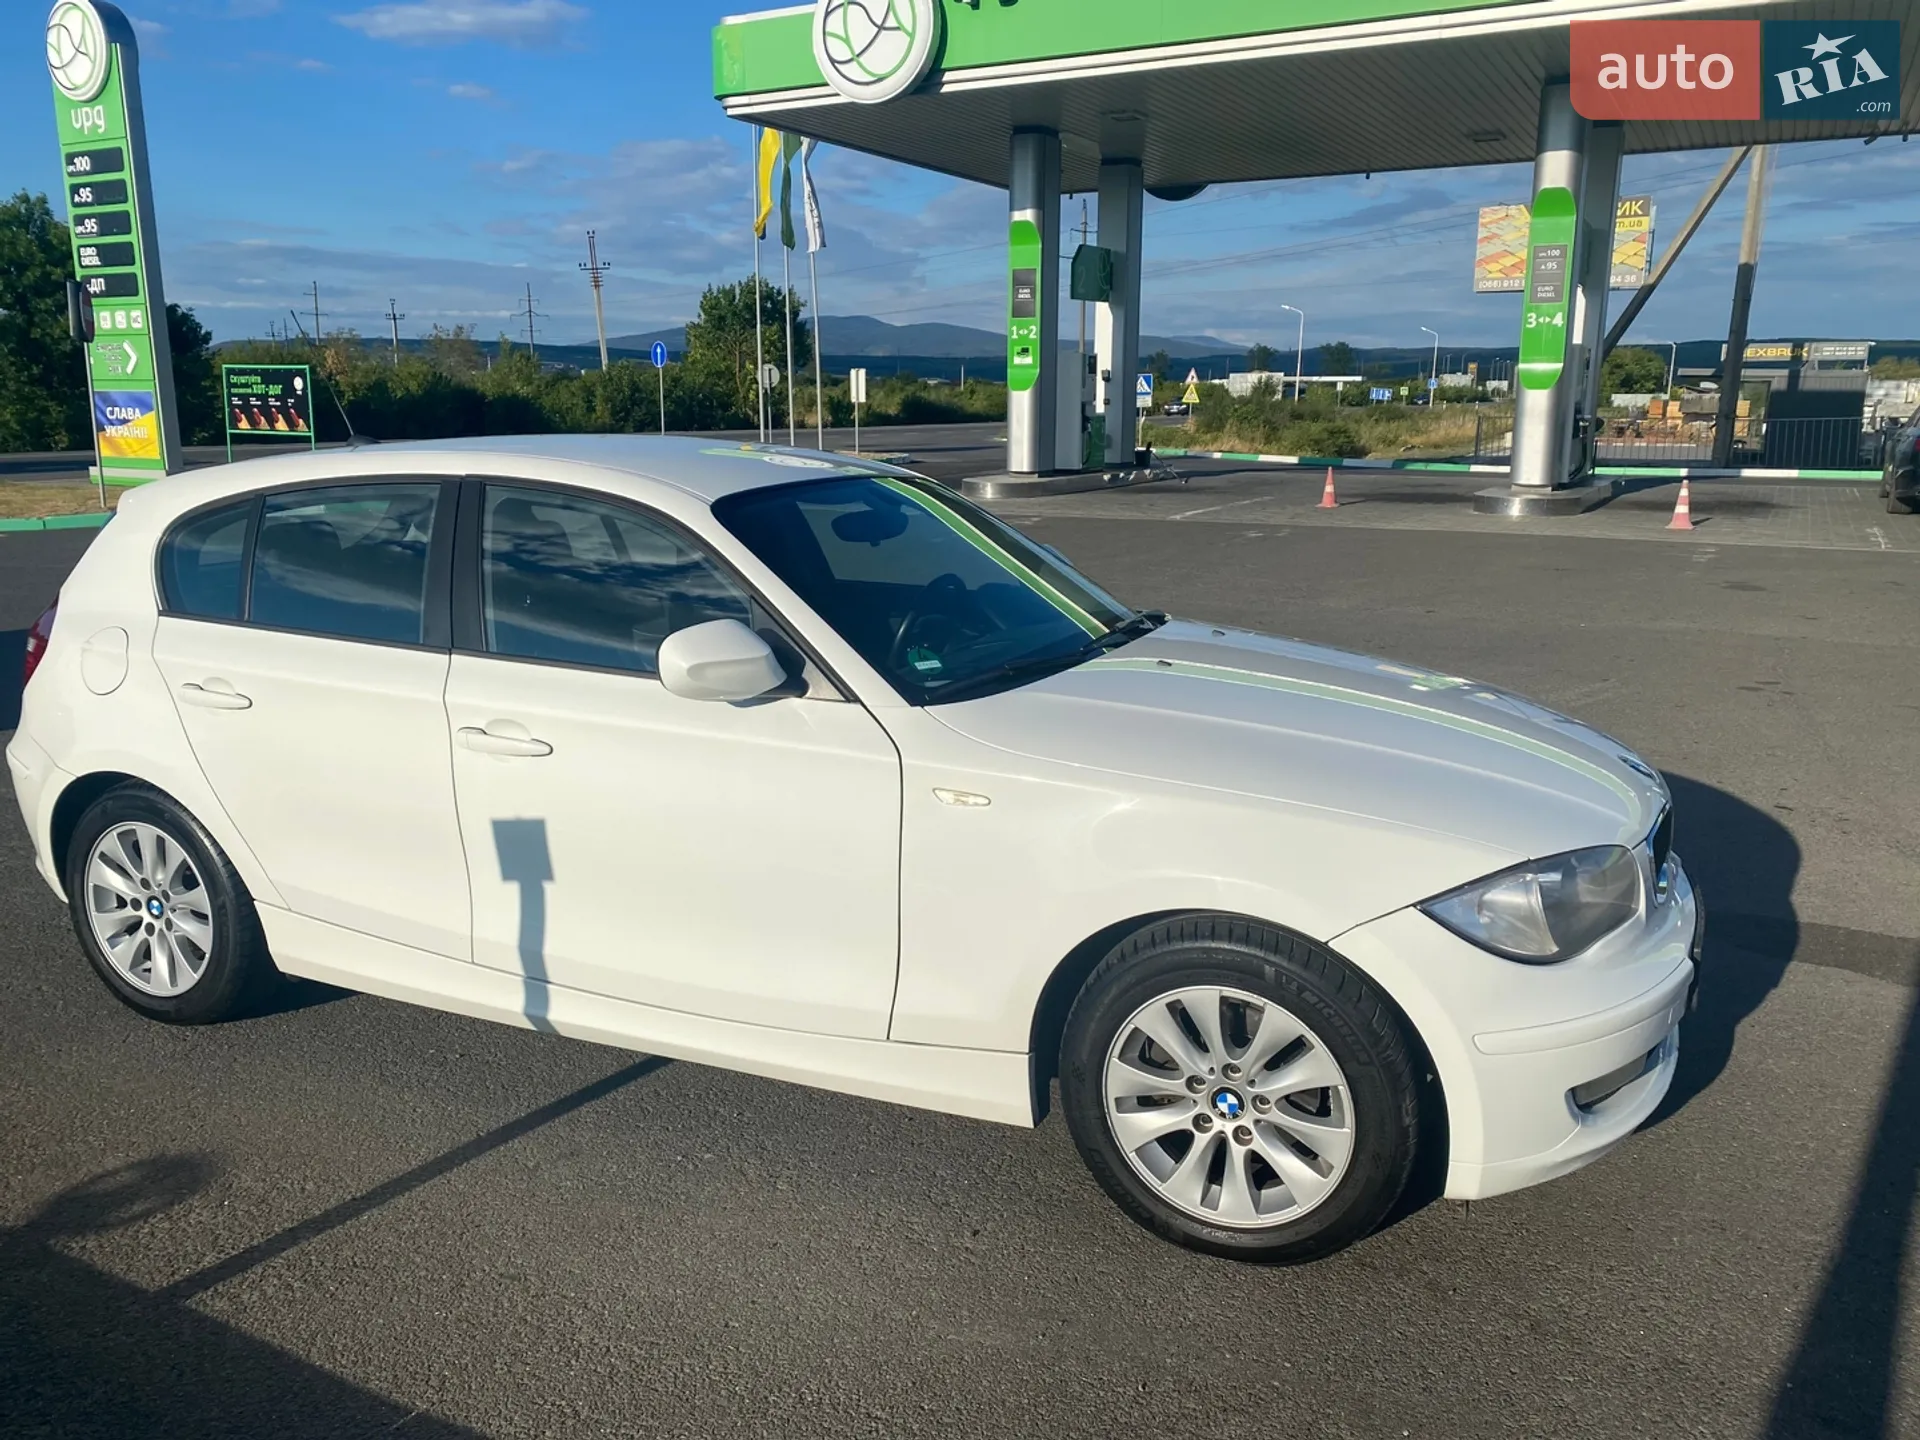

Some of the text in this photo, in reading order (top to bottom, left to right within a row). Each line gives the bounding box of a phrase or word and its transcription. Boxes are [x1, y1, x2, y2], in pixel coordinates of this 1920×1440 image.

[70, 105, 106, 134] upg
[1525, 312, 1564, 328] 3 4
[1010, 325, 1038, 339] 1 2
[106, 406, 142, 420] СЛАВА
[103, 423, 148, 439] УКРАЇНІ!
